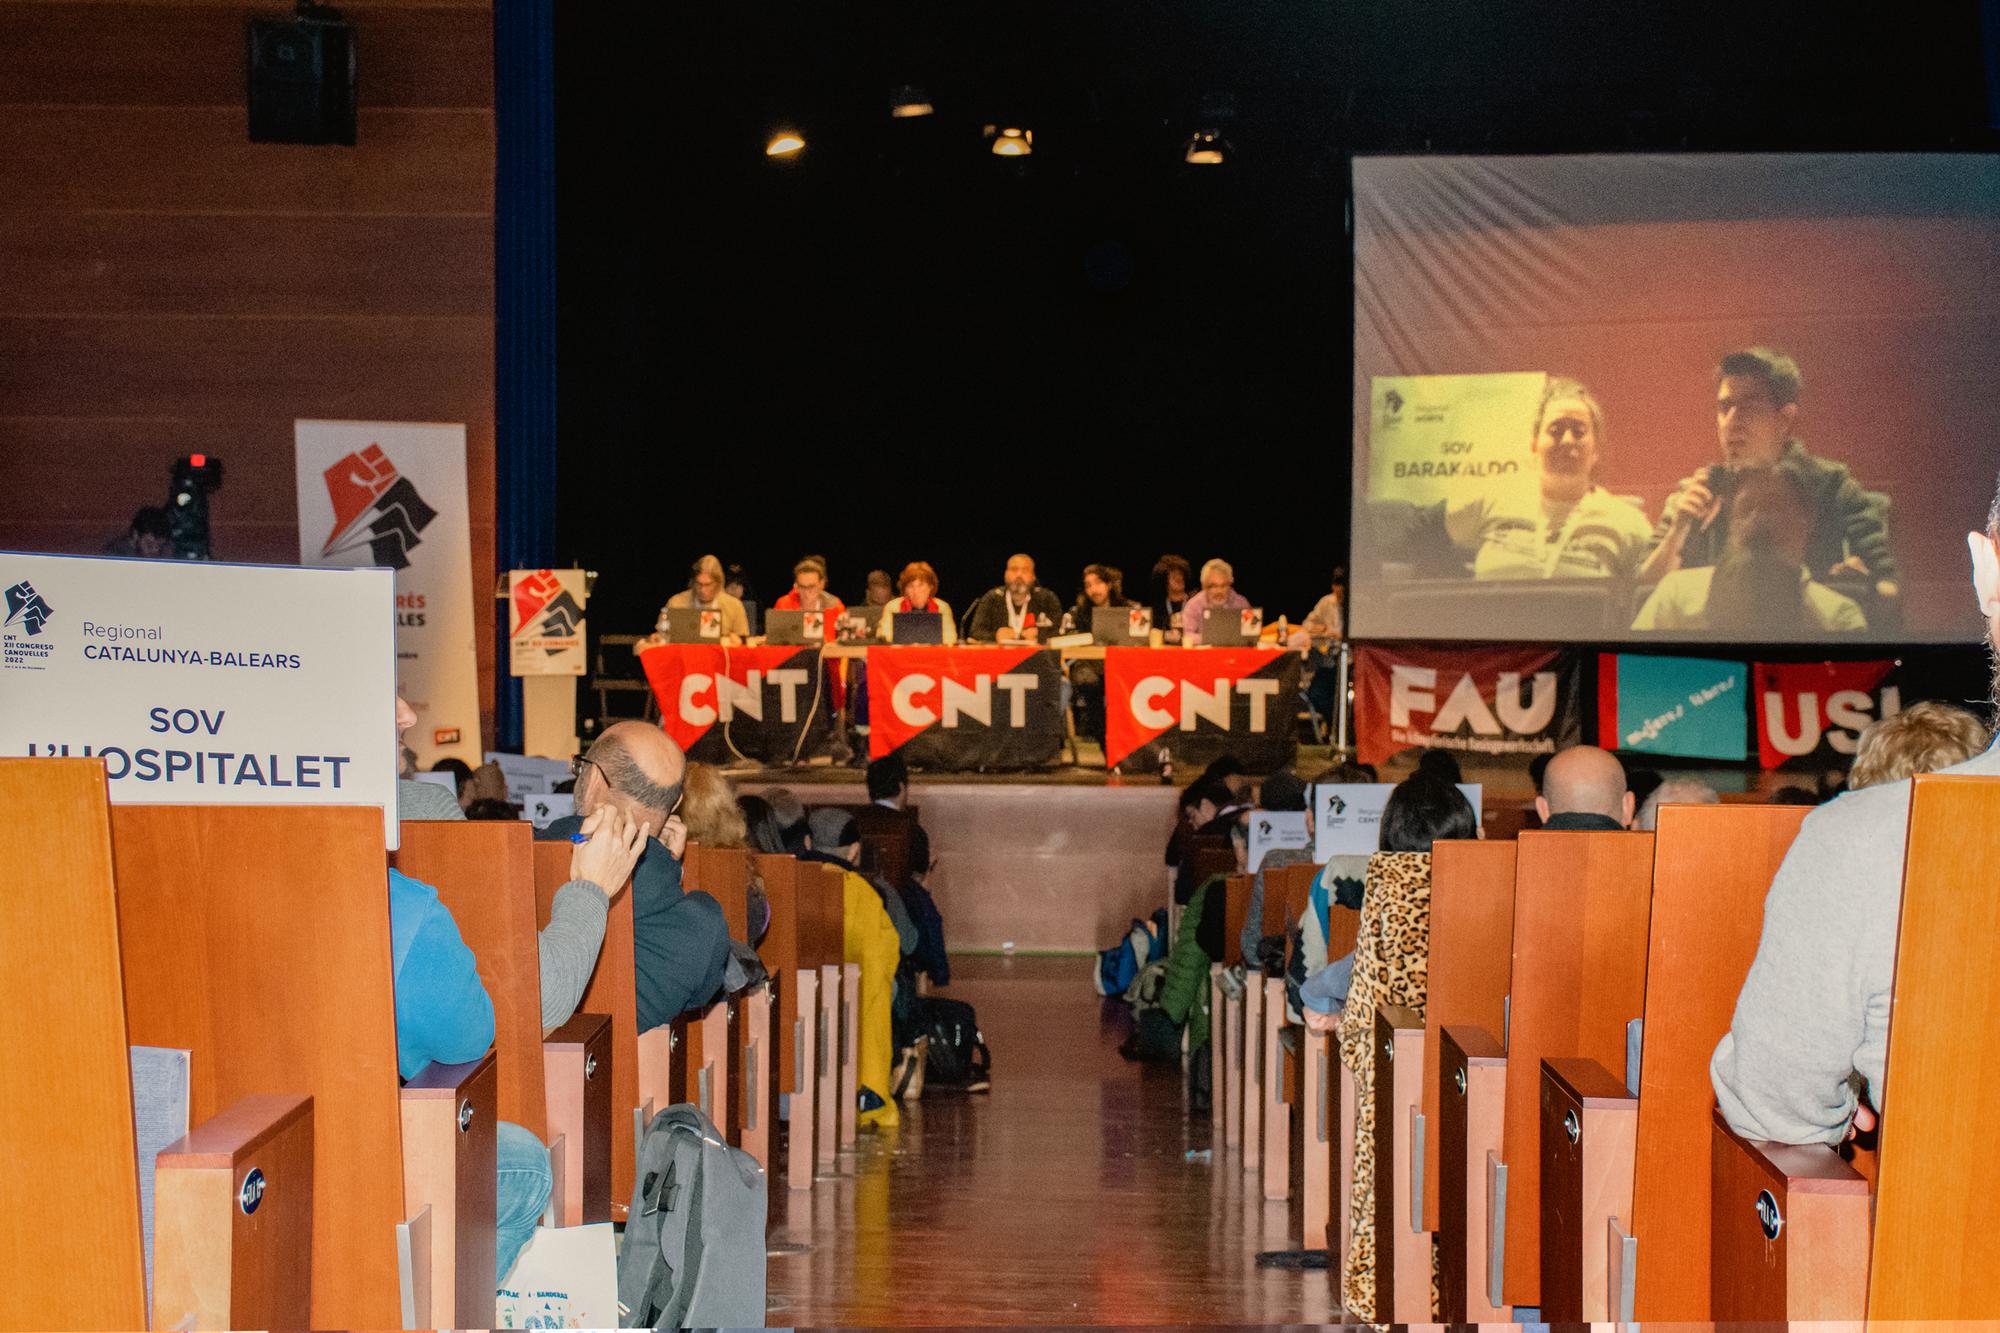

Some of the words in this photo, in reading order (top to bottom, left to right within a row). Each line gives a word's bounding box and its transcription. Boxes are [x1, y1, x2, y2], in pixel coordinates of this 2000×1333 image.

[83, 621, 162, 641] Regional
[84, 645, 301, 669] CATALUNYA-BALEARS
[150, 706, 226, 735] SOV
[679, 668, 808, 727] CNT
[892, 673, 1039, 728] CNT
[1130, 675, 1280, 733] CNT
[1390, 664, 1558, 735] FAU
